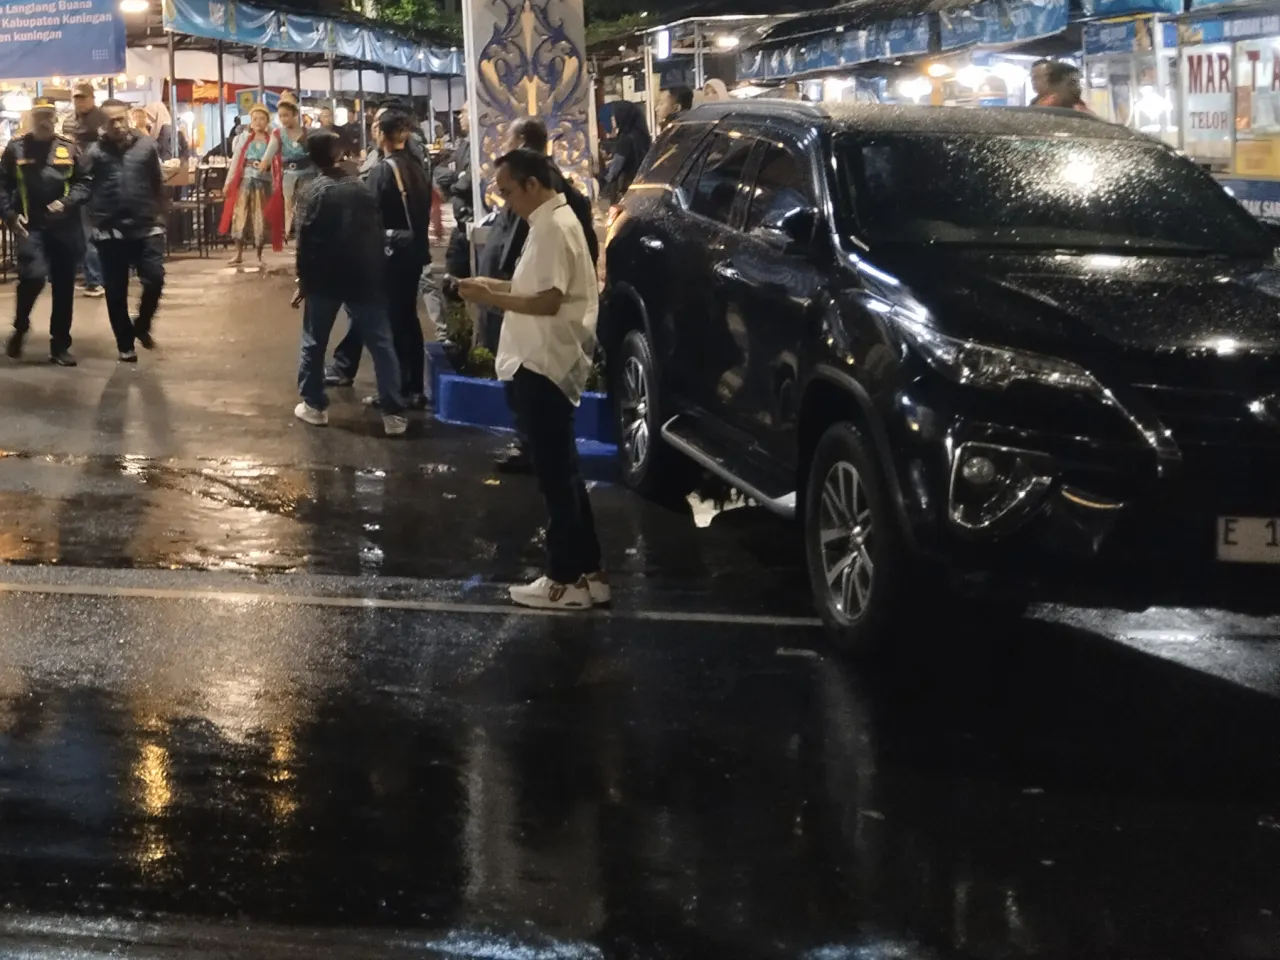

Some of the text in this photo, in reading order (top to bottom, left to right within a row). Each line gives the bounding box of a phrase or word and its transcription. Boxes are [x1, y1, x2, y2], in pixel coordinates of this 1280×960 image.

[6, 2, 57, 15] Langlang
[58, 0, 93, 11] Buana
[2, 16, 60, 28] Kabupaten
[62, 13, 112, 25] Kuningan
[13, 29, 62, 42] kuningan
[1187, 52, 1230, 93] MAR
[1189, 111, 1228, 129] TELOR
[1224, 519, 1239, 546] E
